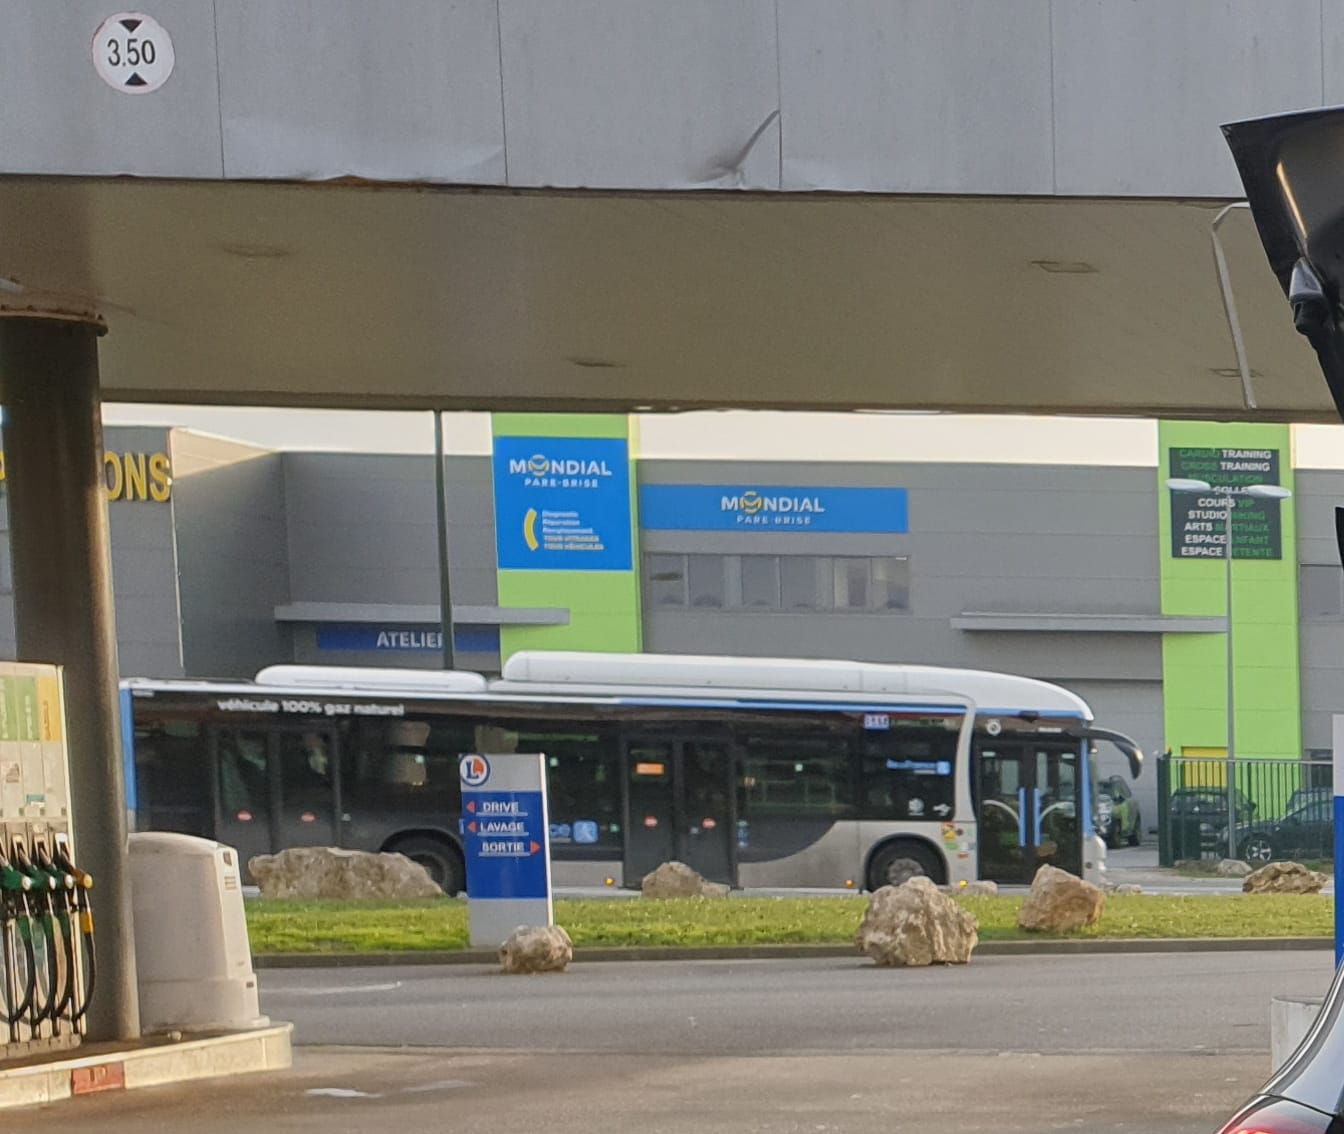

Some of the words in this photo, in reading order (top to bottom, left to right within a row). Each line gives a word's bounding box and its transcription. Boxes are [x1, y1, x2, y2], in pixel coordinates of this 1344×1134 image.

[107, 38, 156, 66] 3.50
[1222, 449, 1272, 459] TRAINING
[509, 454, 612, 477] MONDIAL
[1221, 461, 1271, 471] TRAINING
[721, 491, 825, 514] MONDIAL
[1197, 498, 1236, 508] COURS
[1188, 510, 1228, 520] STUDIO
[1184, 522, 1213, 531] ARTS
[1185, 534, 1228, 544] ESPACE
[1181, 546, 1223, 556] ESPACE
[281, 700, 323, 713] 100%
[482, 801, 519, 813] DRIVE
[480, 821, 525, 833] LAVAGE
